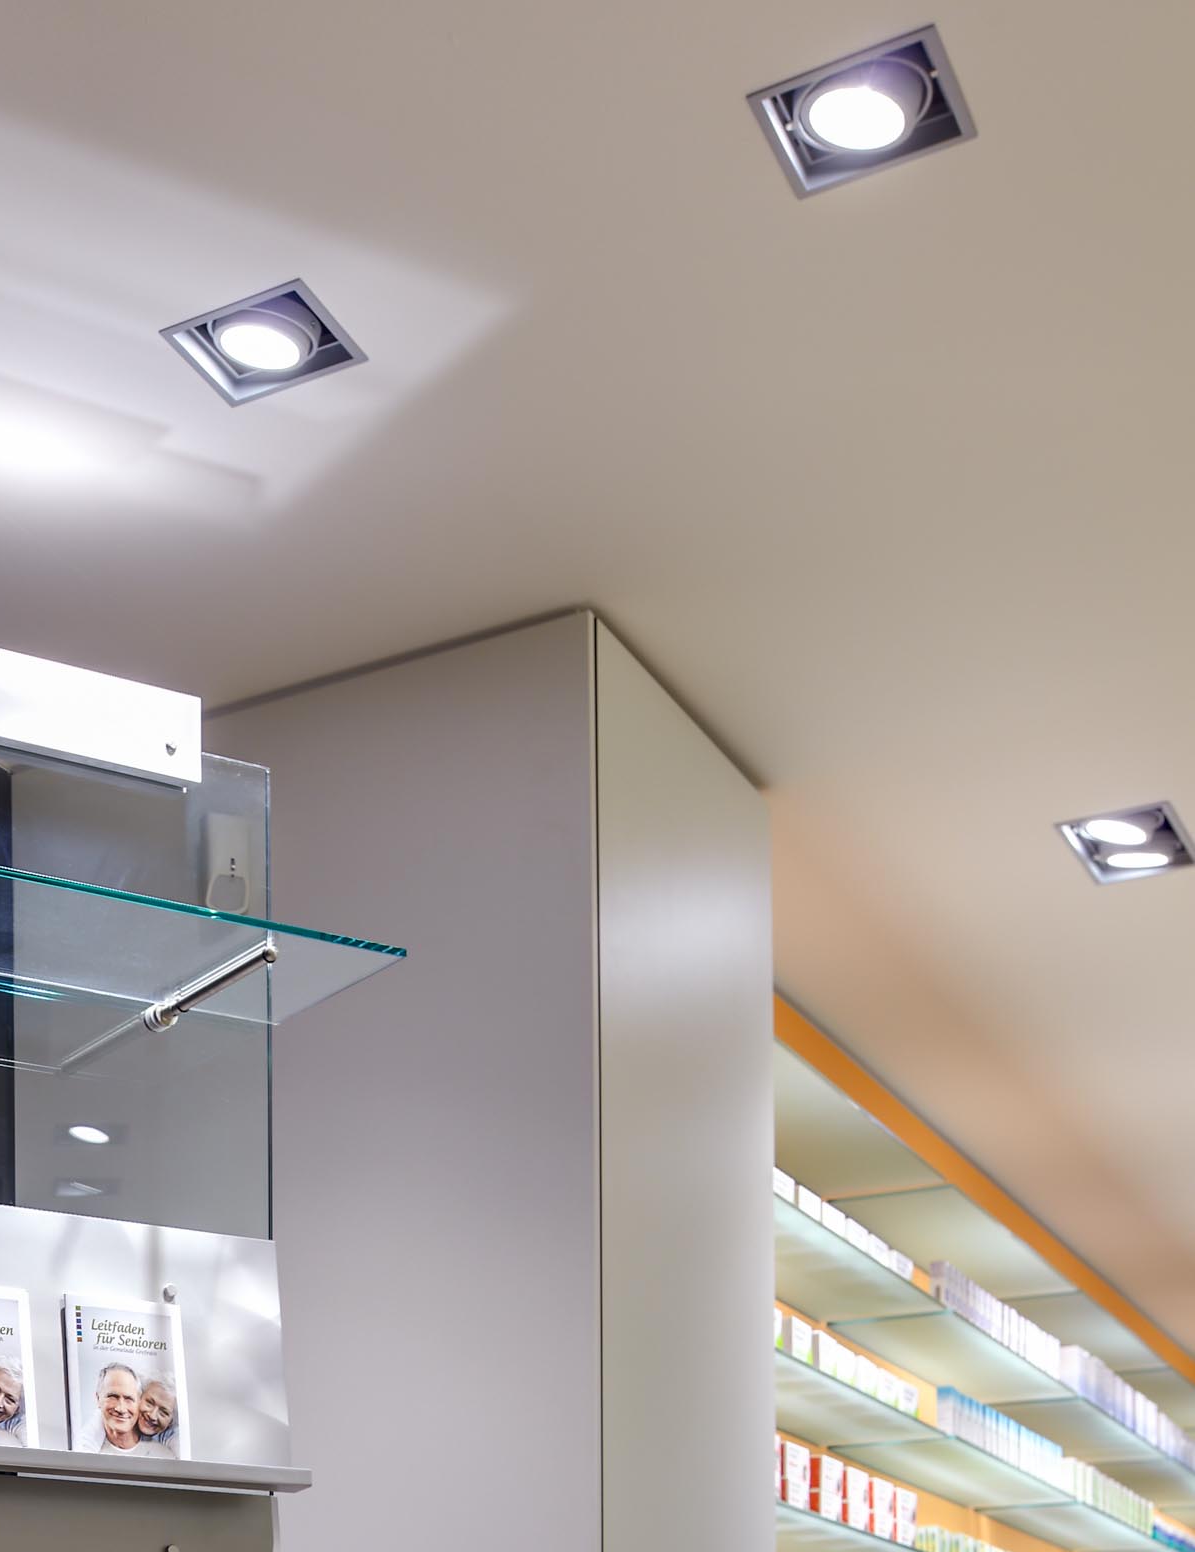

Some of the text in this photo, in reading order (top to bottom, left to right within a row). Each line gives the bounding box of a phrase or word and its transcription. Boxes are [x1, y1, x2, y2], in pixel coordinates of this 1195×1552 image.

[91, 1318, 146, 1336] Leitfaden
[96, 1332, 168, 1351] für Senioren
